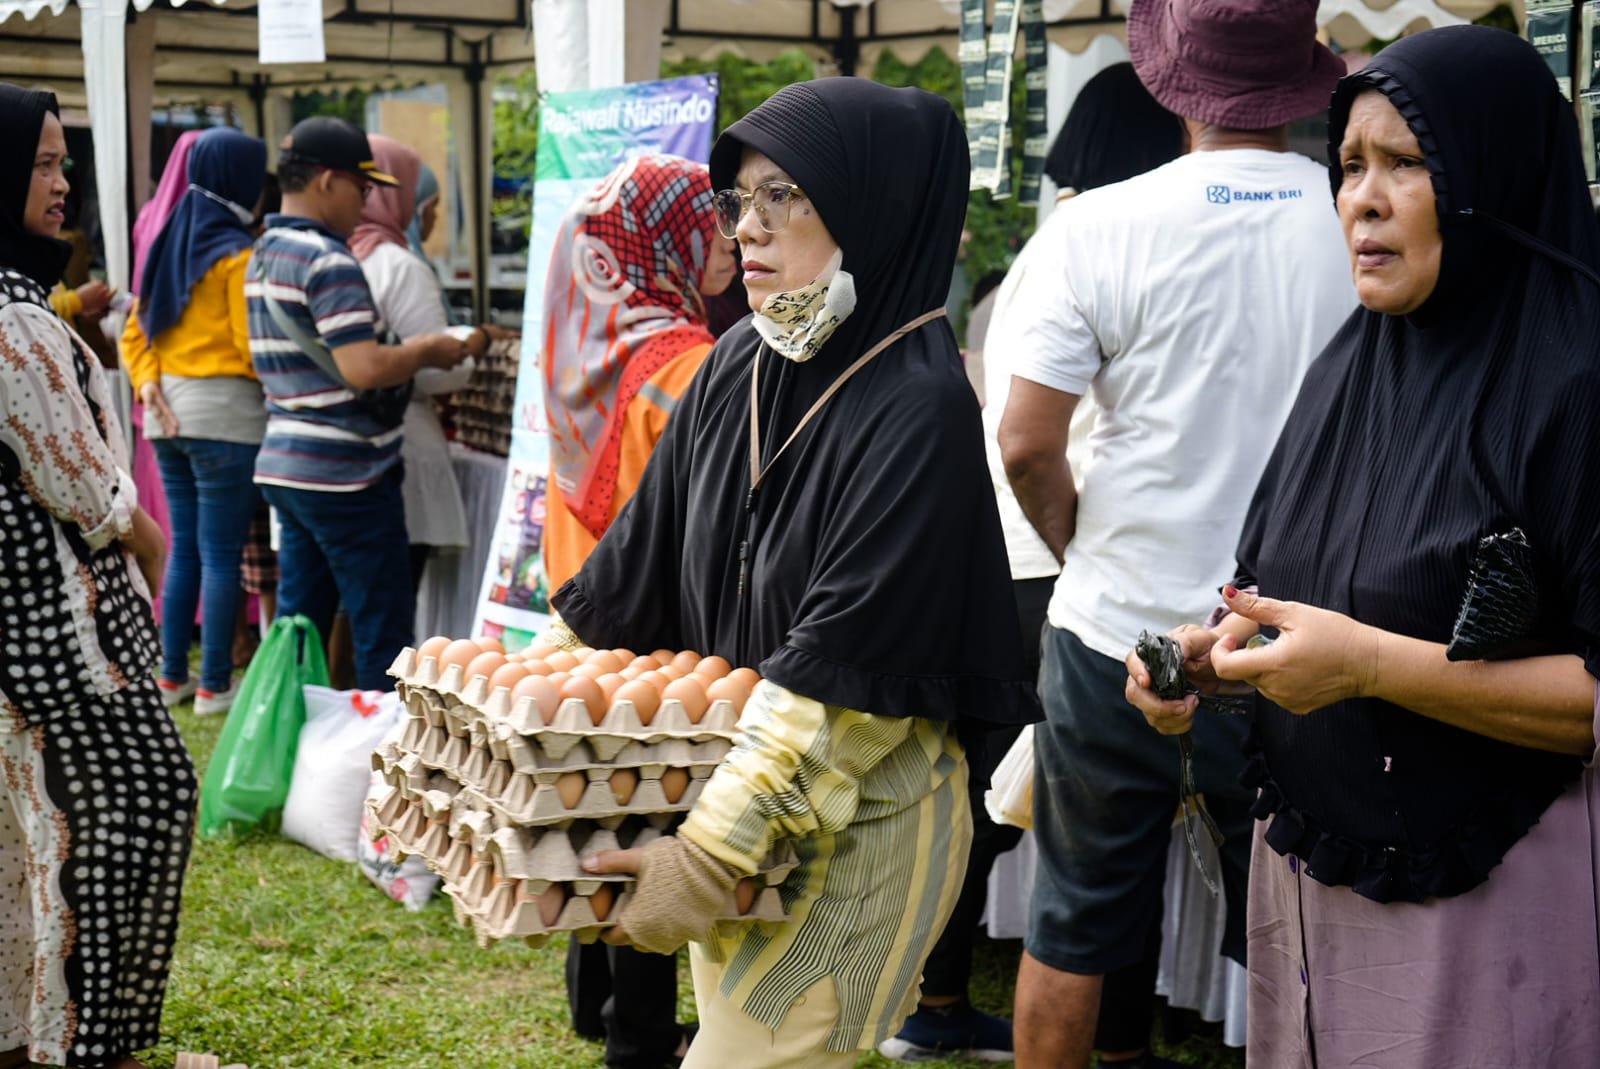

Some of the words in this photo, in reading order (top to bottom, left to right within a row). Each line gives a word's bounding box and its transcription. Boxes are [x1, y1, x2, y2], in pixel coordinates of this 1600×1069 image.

[541, 102, 620, 136] Rajawali
[623, 94, 714, 125] Nusindo
[1233, 191, 1274, 201] BANK
[1278, 189, 1302, 200] BRI
